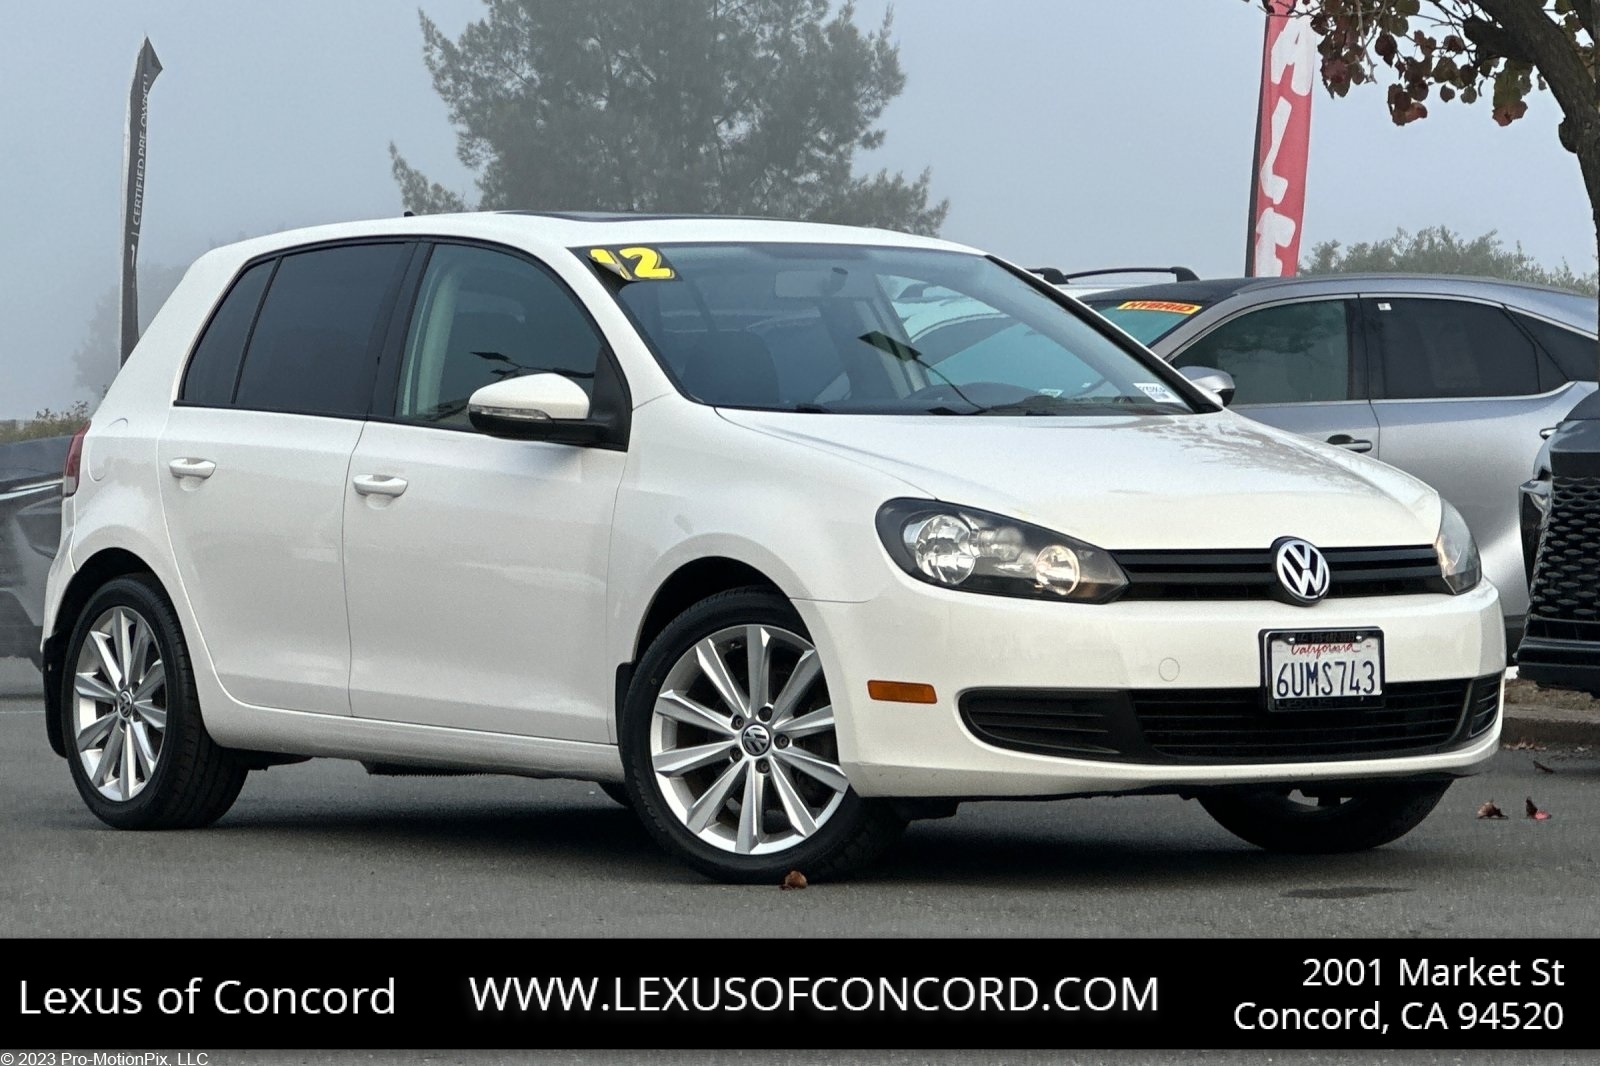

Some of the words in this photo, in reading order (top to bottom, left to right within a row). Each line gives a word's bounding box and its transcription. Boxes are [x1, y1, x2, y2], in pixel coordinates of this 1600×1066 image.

[132, 159, 145, 226] CERTIFIED
[1291, 641, 1361, 660] California
[1275, 660, 1376, 698] 6UMS743
